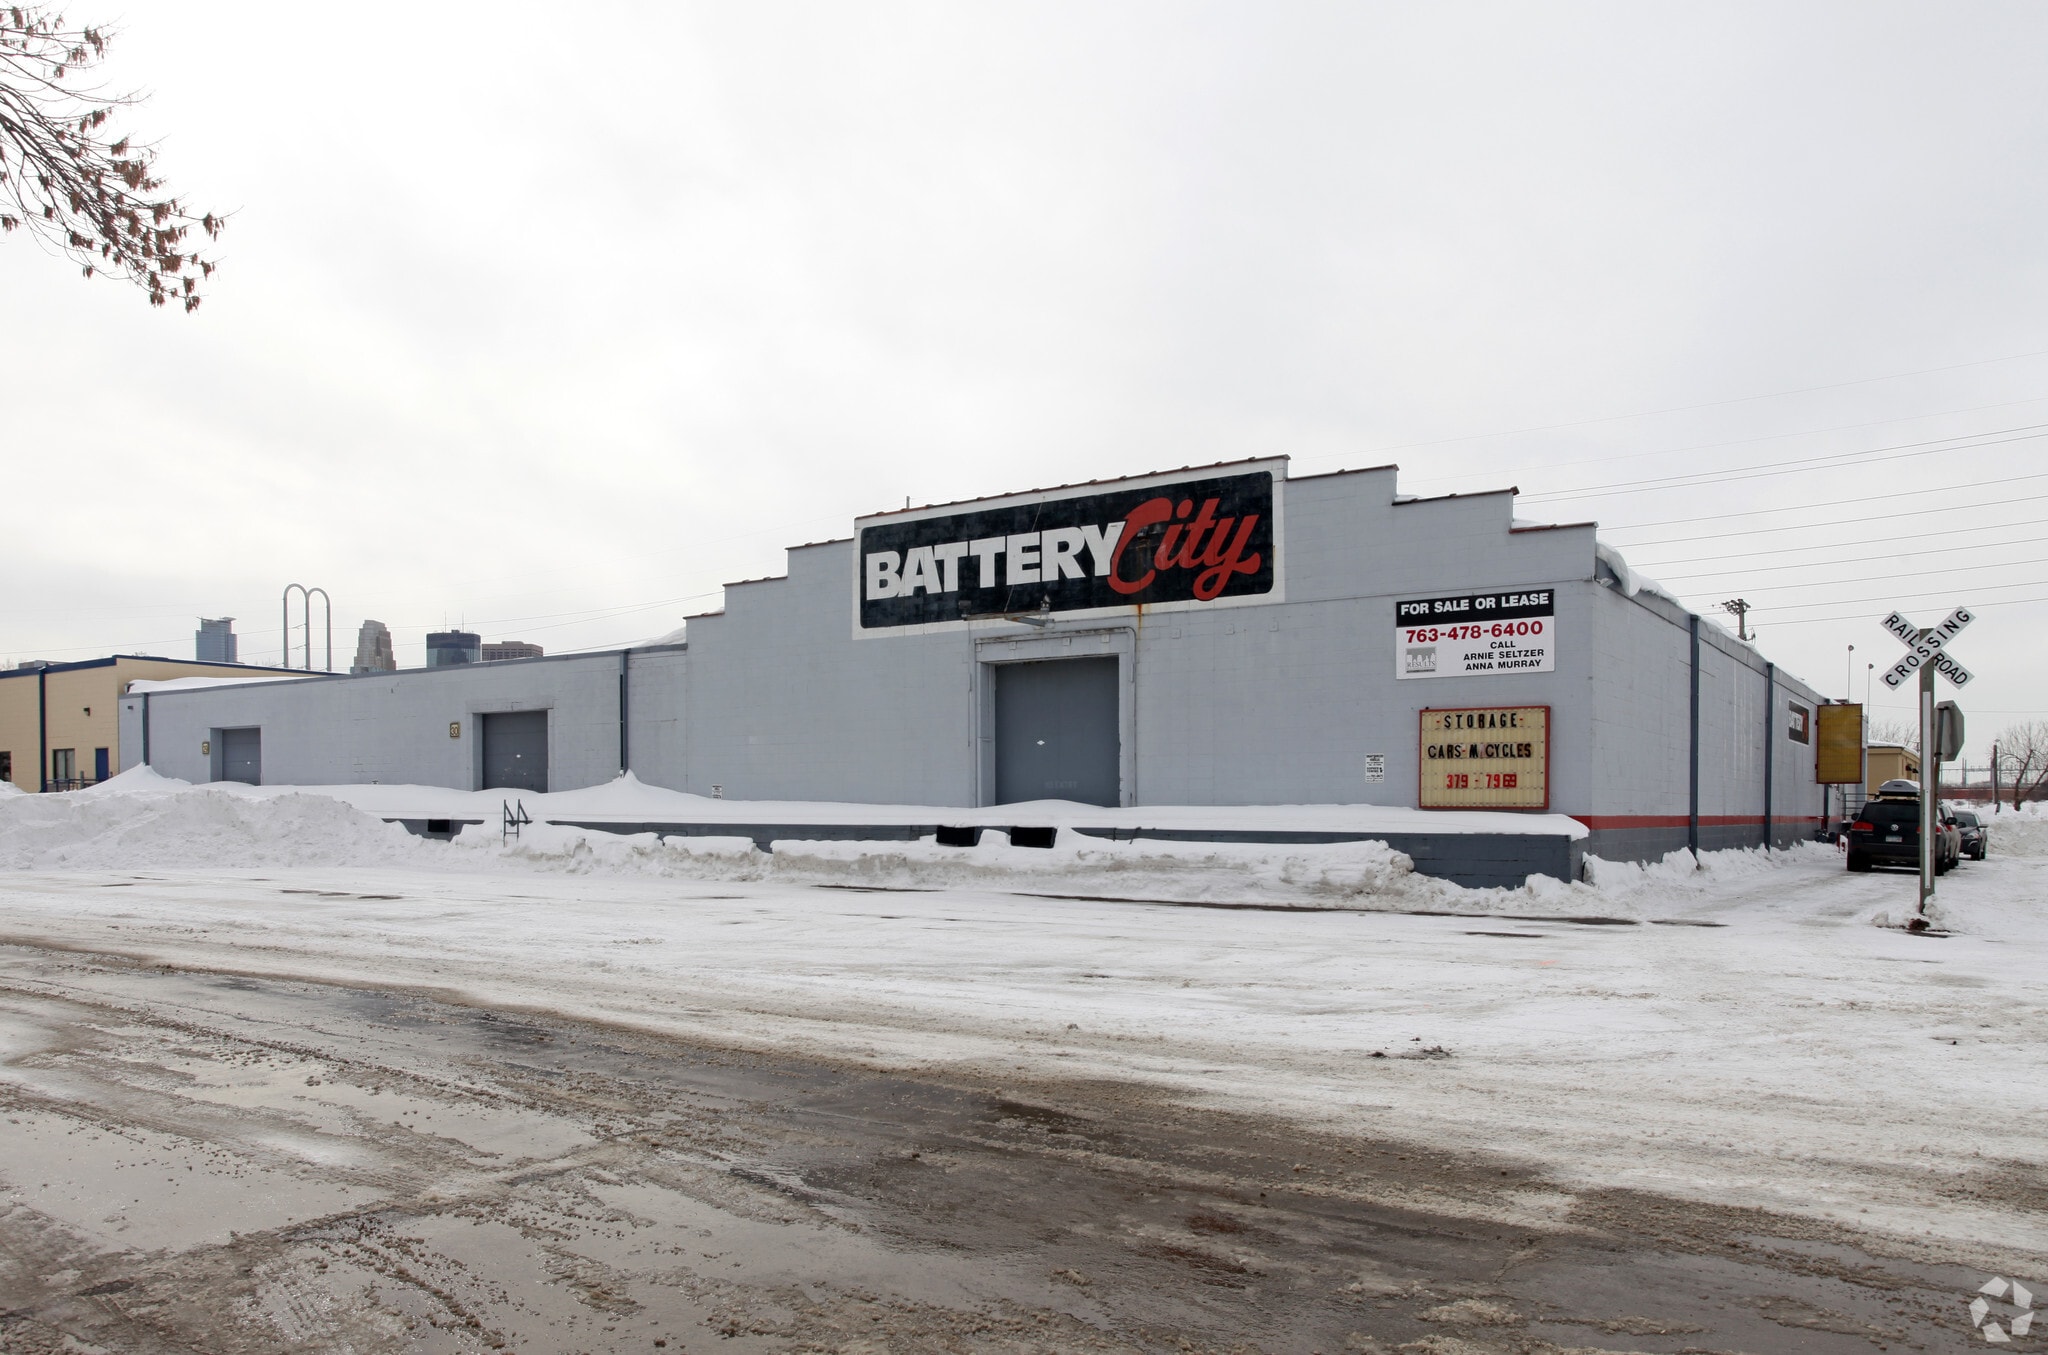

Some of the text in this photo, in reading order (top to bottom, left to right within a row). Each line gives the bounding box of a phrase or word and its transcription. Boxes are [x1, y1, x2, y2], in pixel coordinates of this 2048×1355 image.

[866, 497, 1261, 601] BATTERY City
[1401, 593, 1549, 615] FOR SALE OR LEASE
[1406, 621, 1543, 643] 763-478-6400
[1463, 649, 1544, 661] ARNIE SELTZER
[1490, 641, 1516, 649] CALL
[1884, 614, 1968, 685] RAIL ROAD
[1885, 610, 1970, 686] CROSSING
[1465, 659, 1542, 671] ANNA MURRAY
